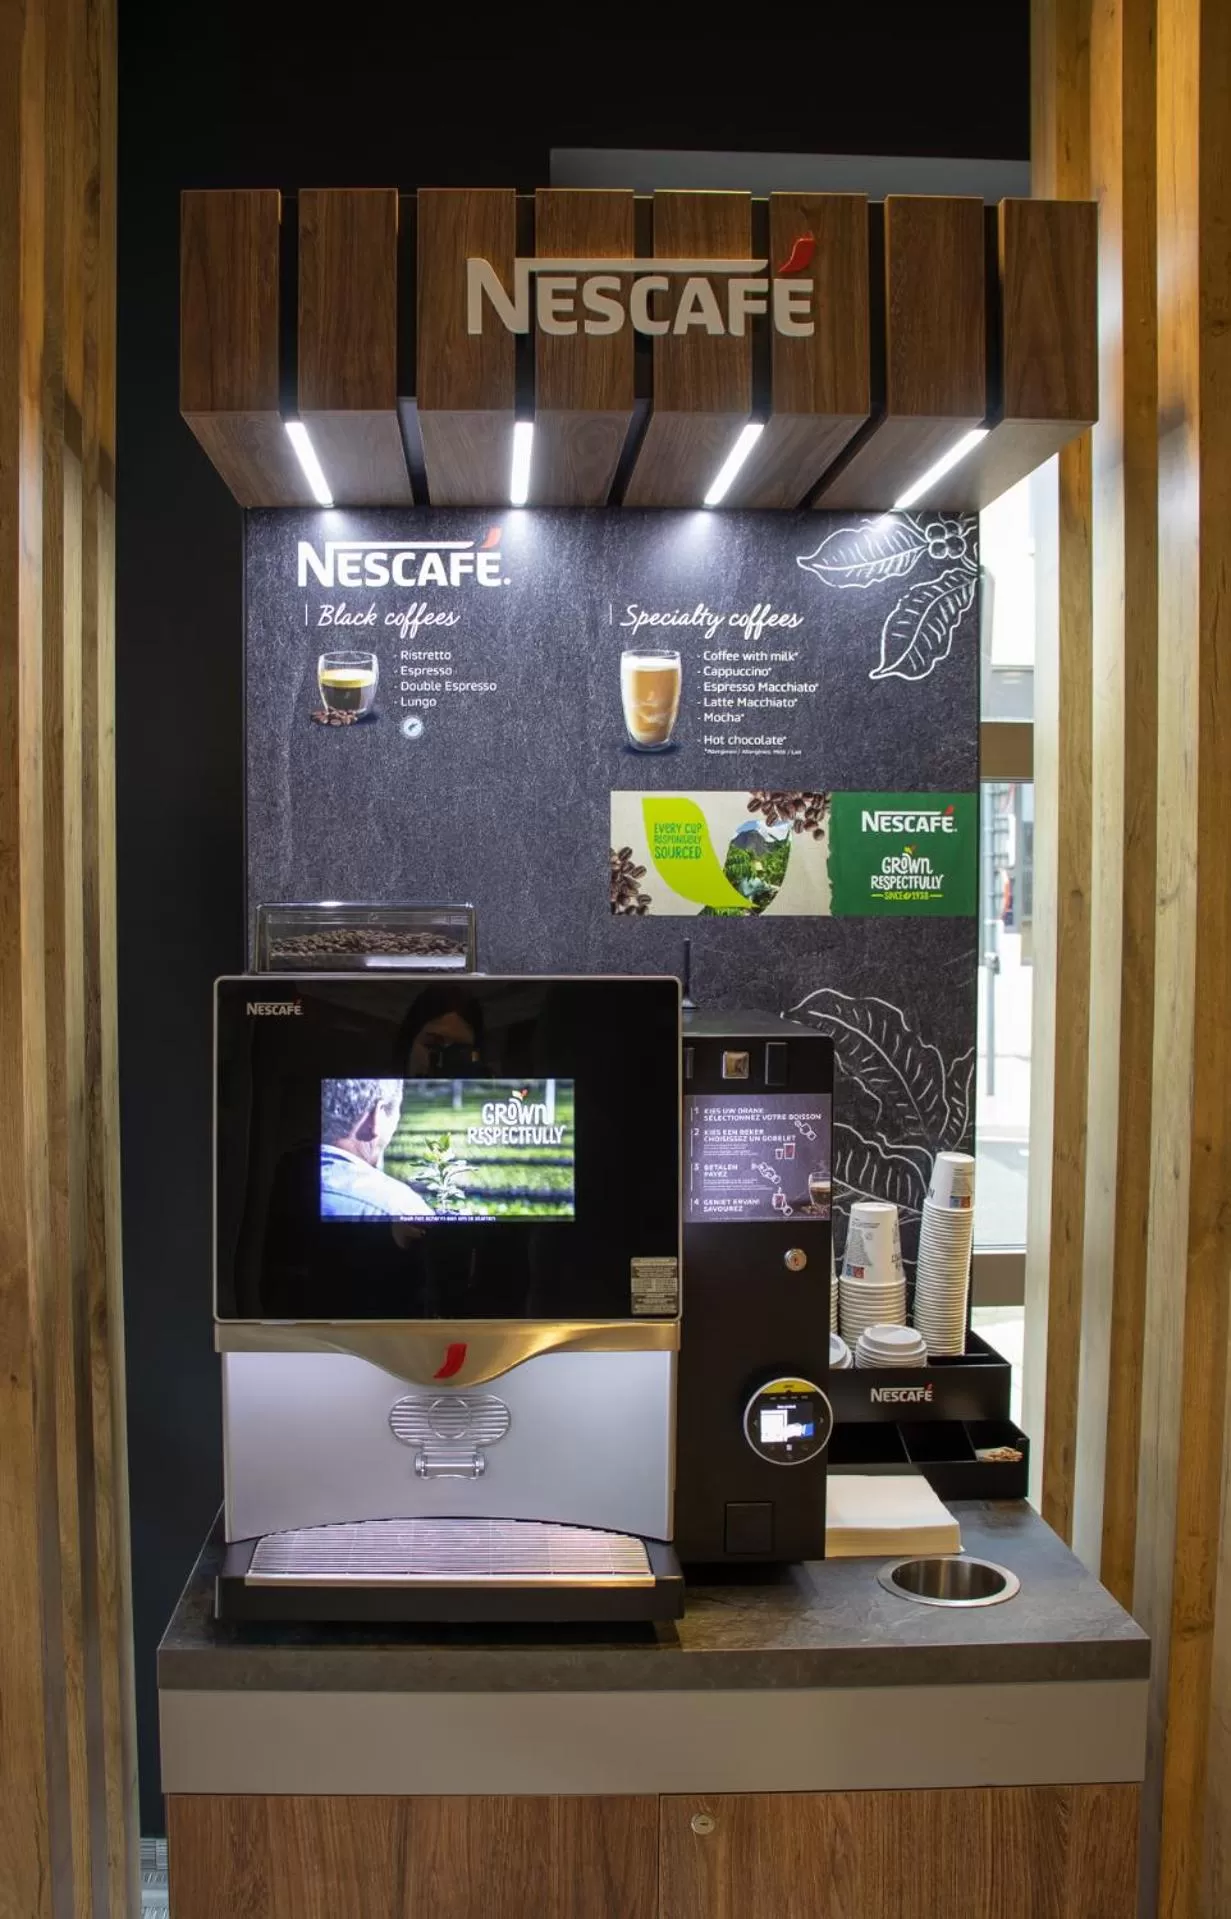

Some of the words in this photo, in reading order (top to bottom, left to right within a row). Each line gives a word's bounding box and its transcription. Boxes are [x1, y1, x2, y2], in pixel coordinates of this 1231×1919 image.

[467, 231, 815, 337] NESCAFÉ
[317, 603, 377, 627] Black
[384, 603, 461, 640] coffees
[620, 603, 725, 640] Specialty
[728, 603, 804, 641] coffees
[400, 649, 451, 661] Ristretto
[703, 650, 740, 661] Coffee
[742, 650, 768, 661] with
[400, 665, 452, 677] Espresso
[400, 680, 442, 692] Double
[445, 681, 497, 693] Espresso
[703, 682, 755, 694] Espresso
[400, 696, 437, 709] Lungo
[703, 697, 734, 708] Latte
[703, 735, 725, 745] Hot
[654, 823, 681, 834] EVERY
[685, 823, 702, 834] CUP
[655, 846, 702, 860] SOURCED
[881, 853, 933, 874] GROWN
[871, 874, 944, 890] RESPECTFULLY
[482, 1098, 554, 1125] GROWN
[788, 1113, 822, 1121] BOISSON
[467, 1125, 567, 1145] RESPECTFULLY
